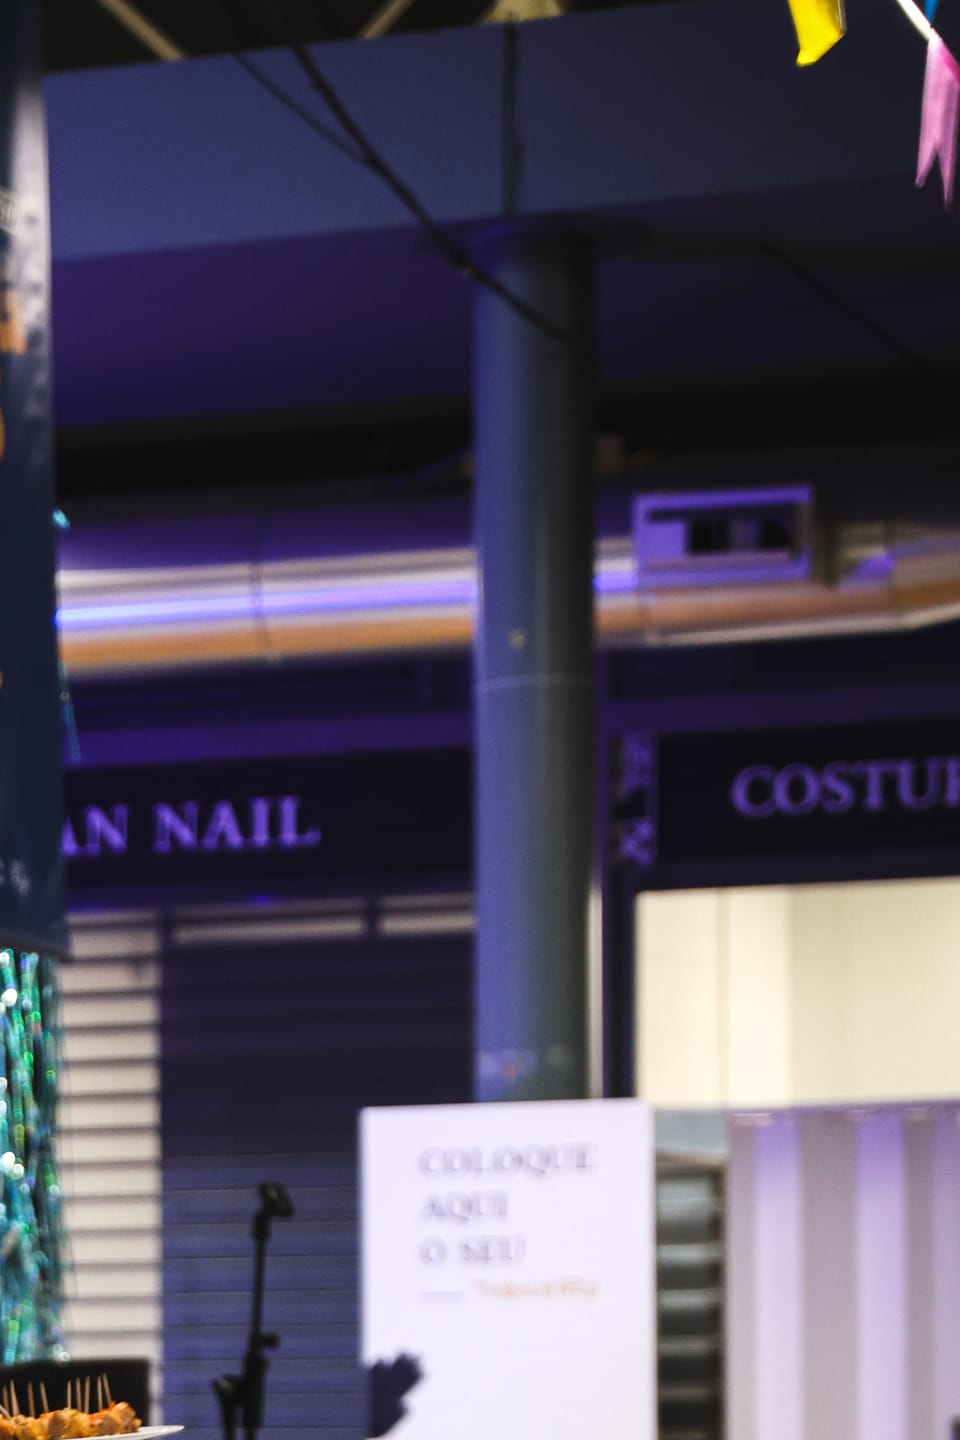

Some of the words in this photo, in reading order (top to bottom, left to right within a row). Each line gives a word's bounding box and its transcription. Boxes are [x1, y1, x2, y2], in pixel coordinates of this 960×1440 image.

[154, 796, 321, 853] NAIL
[418, 1142, 597, 1180] COLOQUE
[421, 1190, 509, 1223] AQUI
